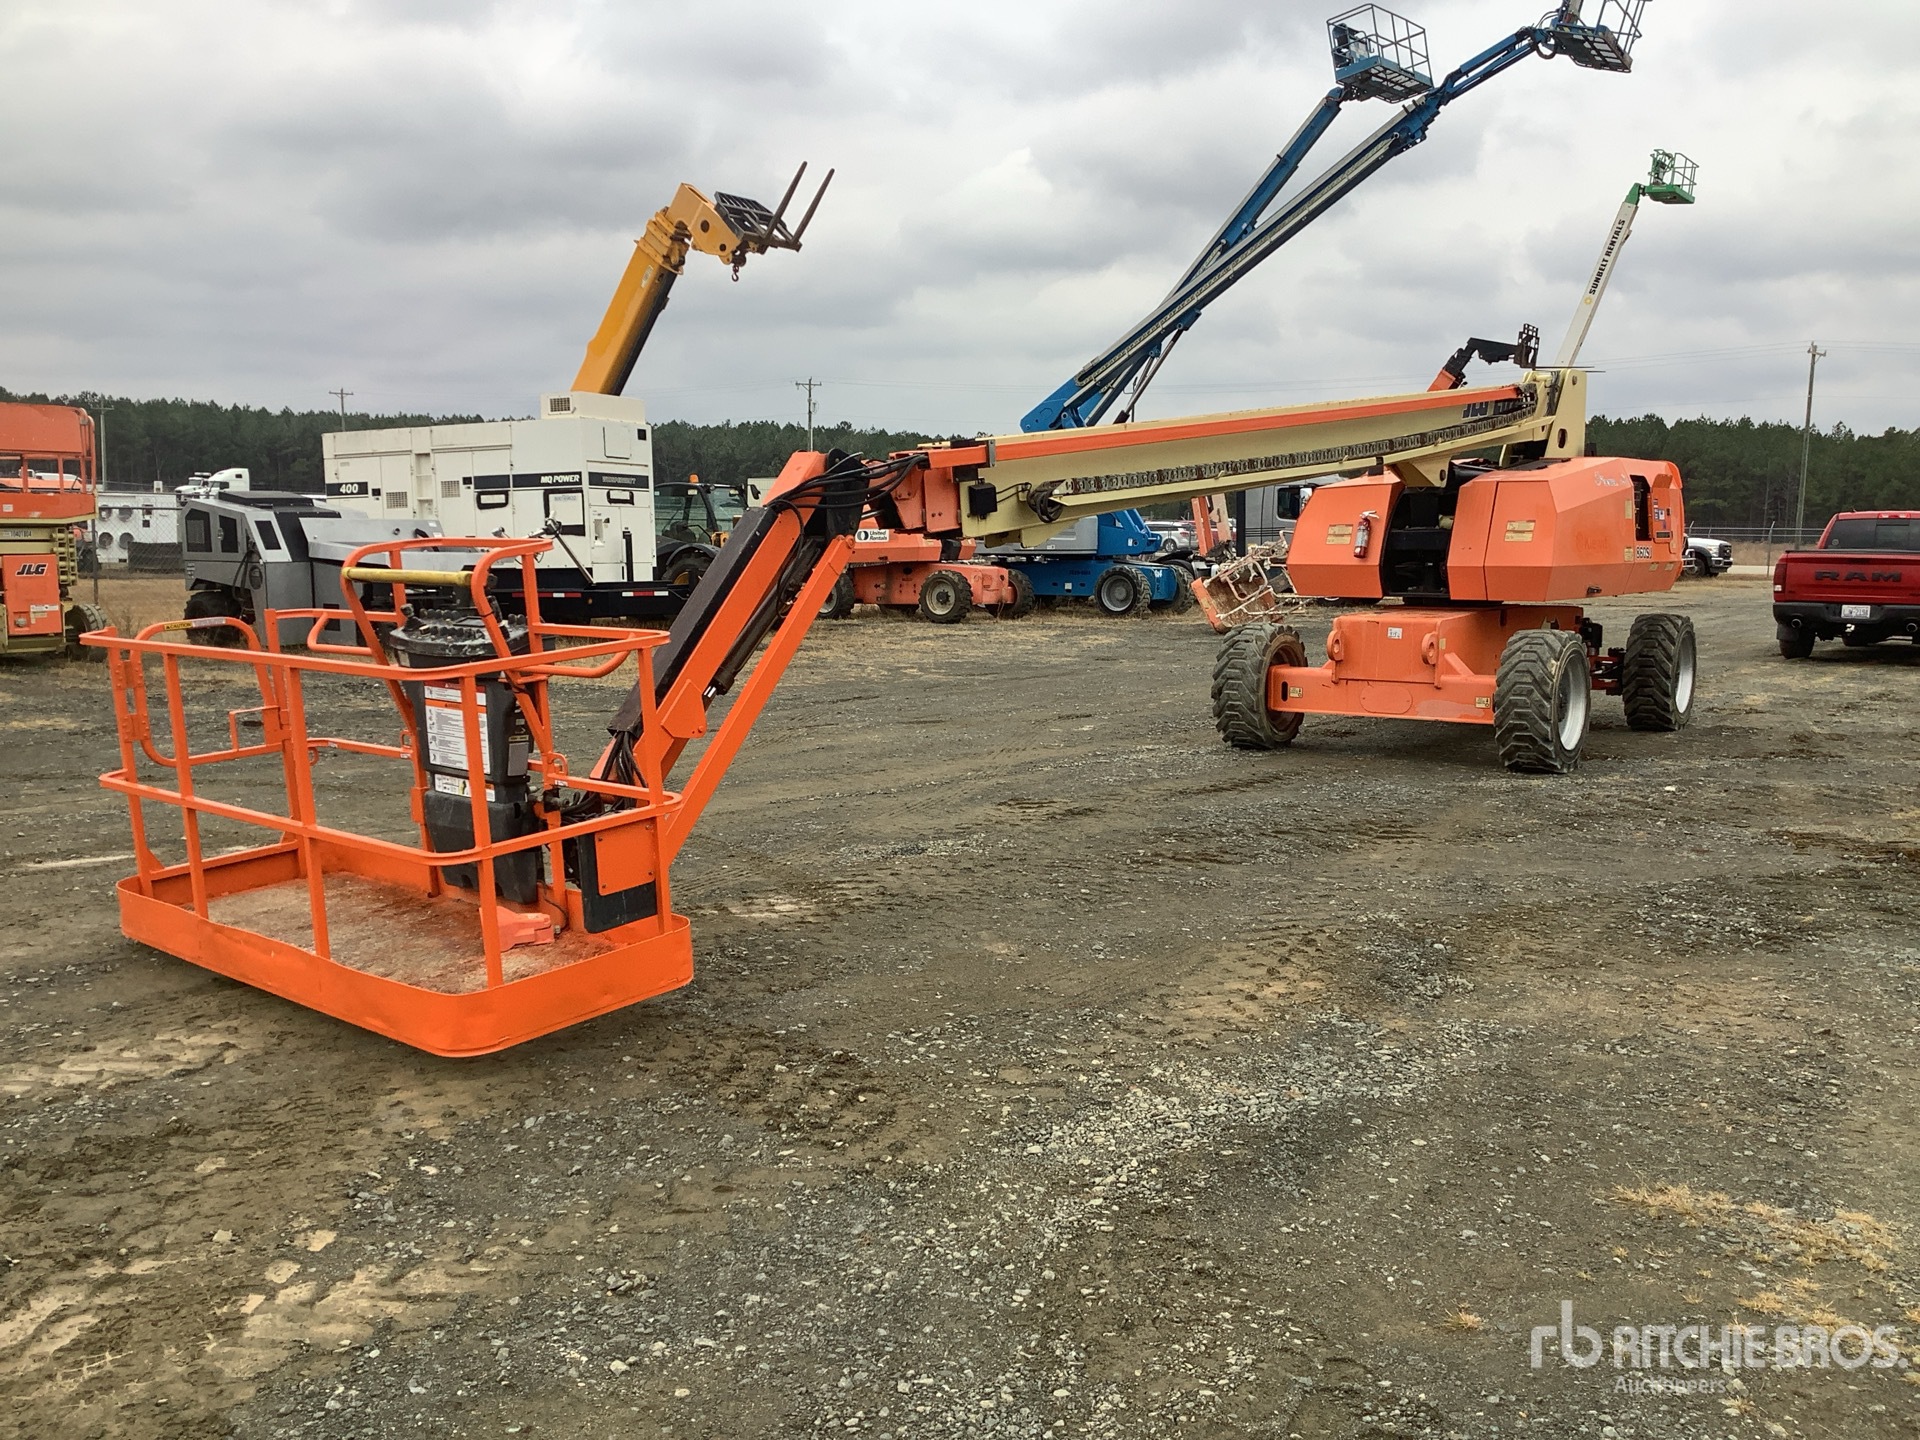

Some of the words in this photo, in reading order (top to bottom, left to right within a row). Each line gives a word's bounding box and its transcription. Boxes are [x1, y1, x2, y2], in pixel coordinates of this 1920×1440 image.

[1588, 258, 1609, 295] SUNBELT
[1604, 219, 1626, 257] RENTALS
[540, 476, 553, 484] MQ
[553, 475, 580, 483] POWER
[340, 483, 358, 494] 400
[16, 564, 47, 575] JLG
[1814, 570, 1902, 582] RAM
